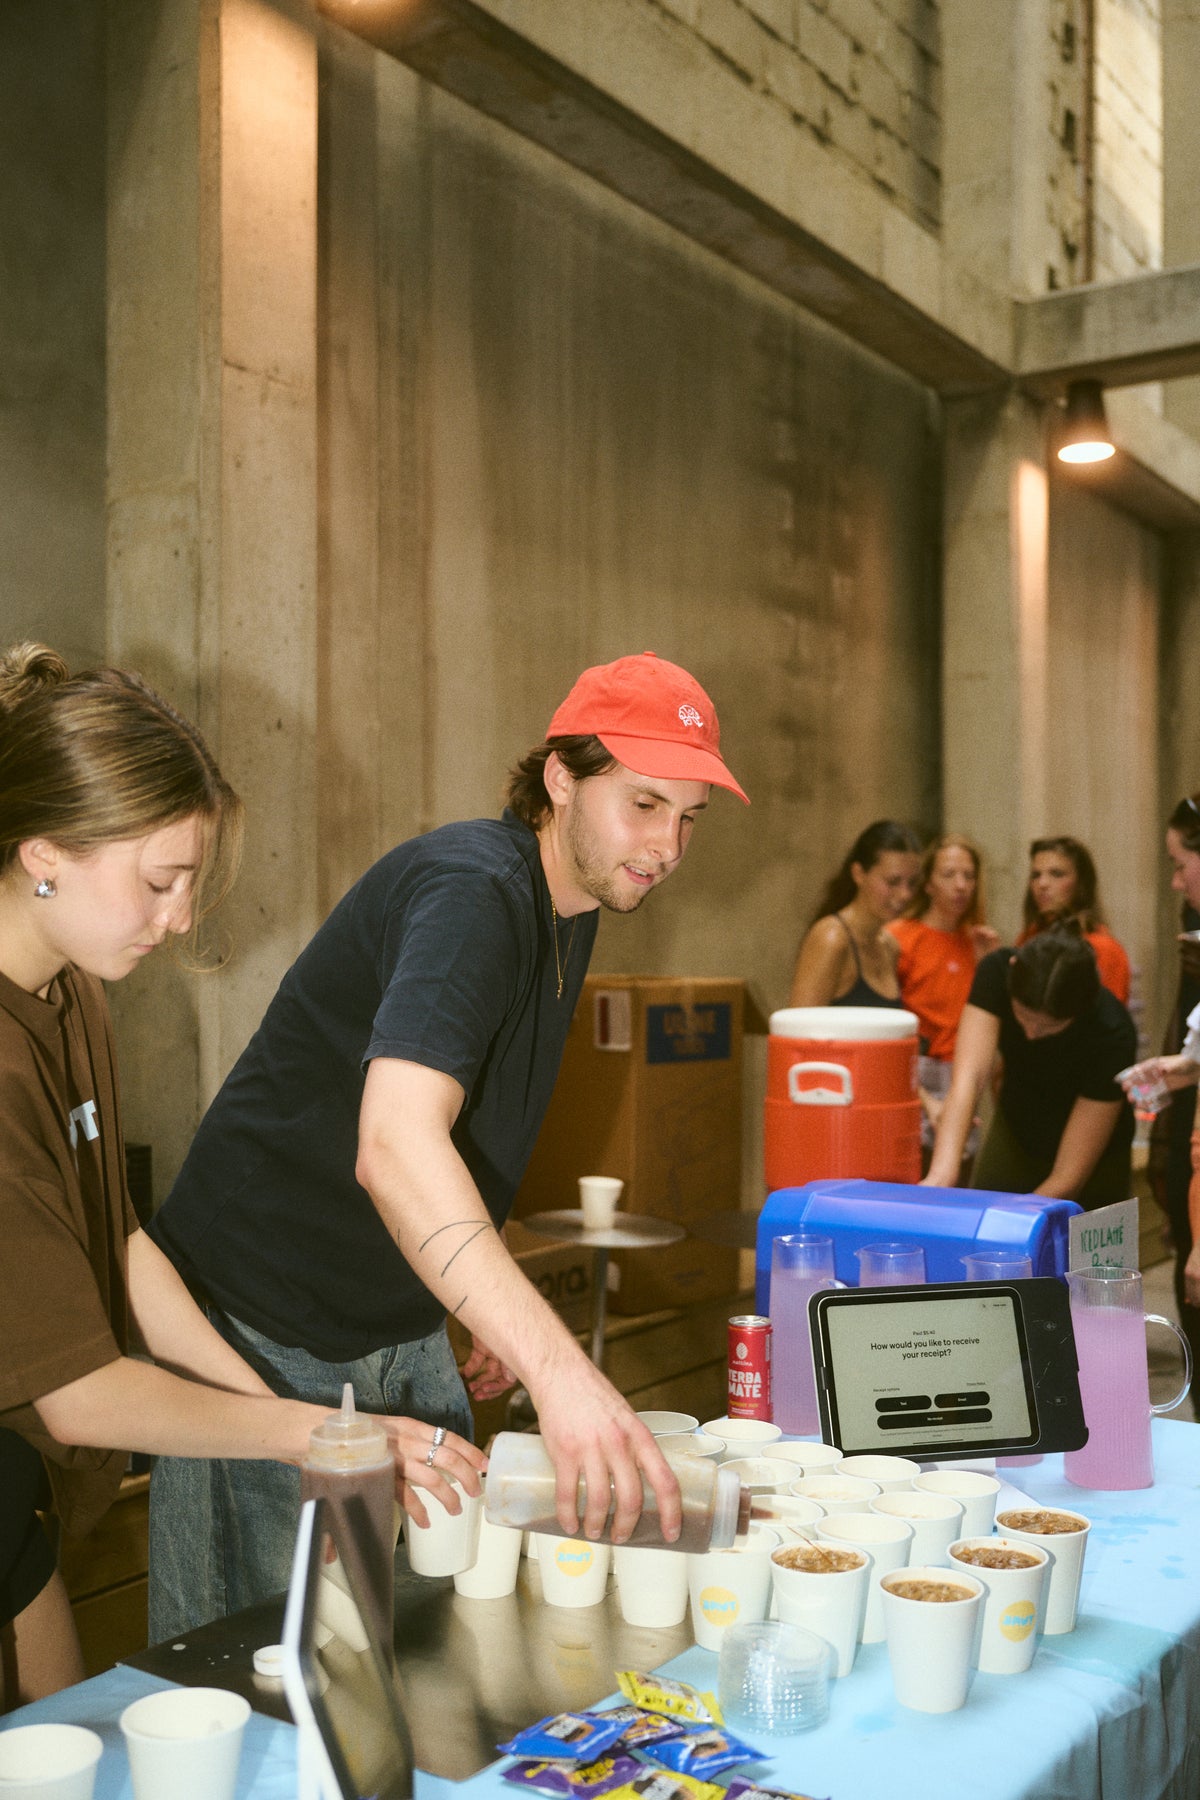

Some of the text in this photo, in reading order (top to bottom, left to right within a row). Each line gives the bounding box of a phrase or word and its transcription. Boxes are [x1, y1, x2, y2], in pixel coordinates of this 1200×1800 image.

[870, 1337, 980, 1350] How would you like to receive
[902, 1348, 952, 1360] your receipt?
[728, 1382, 762, 1398] MATE
